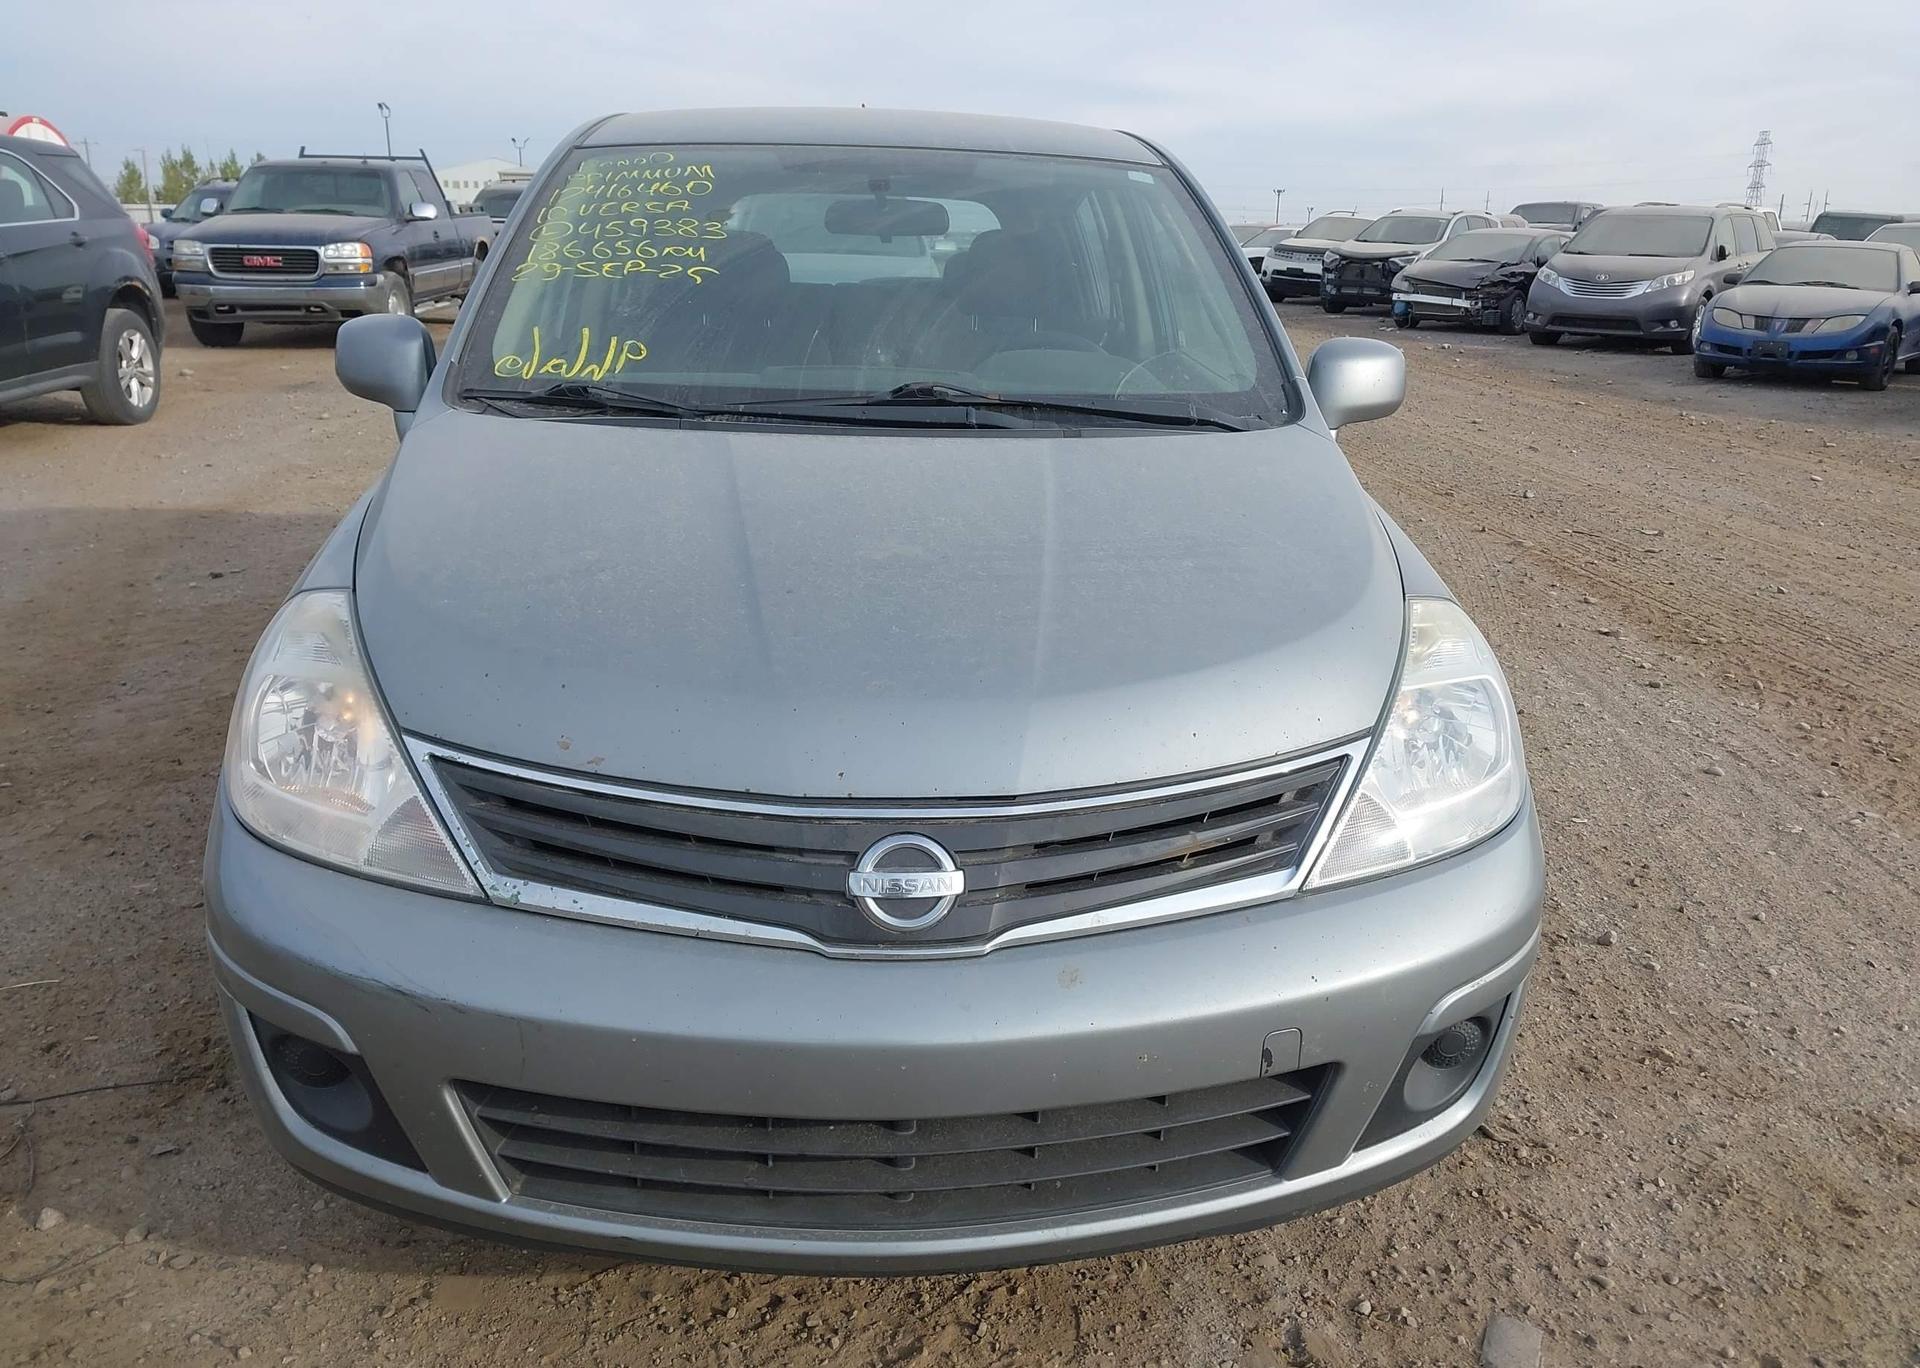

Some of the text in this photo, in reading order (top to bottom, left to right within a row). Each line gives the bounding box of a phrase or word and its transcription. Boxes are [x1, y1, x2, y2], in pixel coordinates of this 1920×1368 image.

[579, 200, 692, 217] VERSA
[243, 255, 283, 267] GMC
[861, 876, 953, 894] NISSAN
